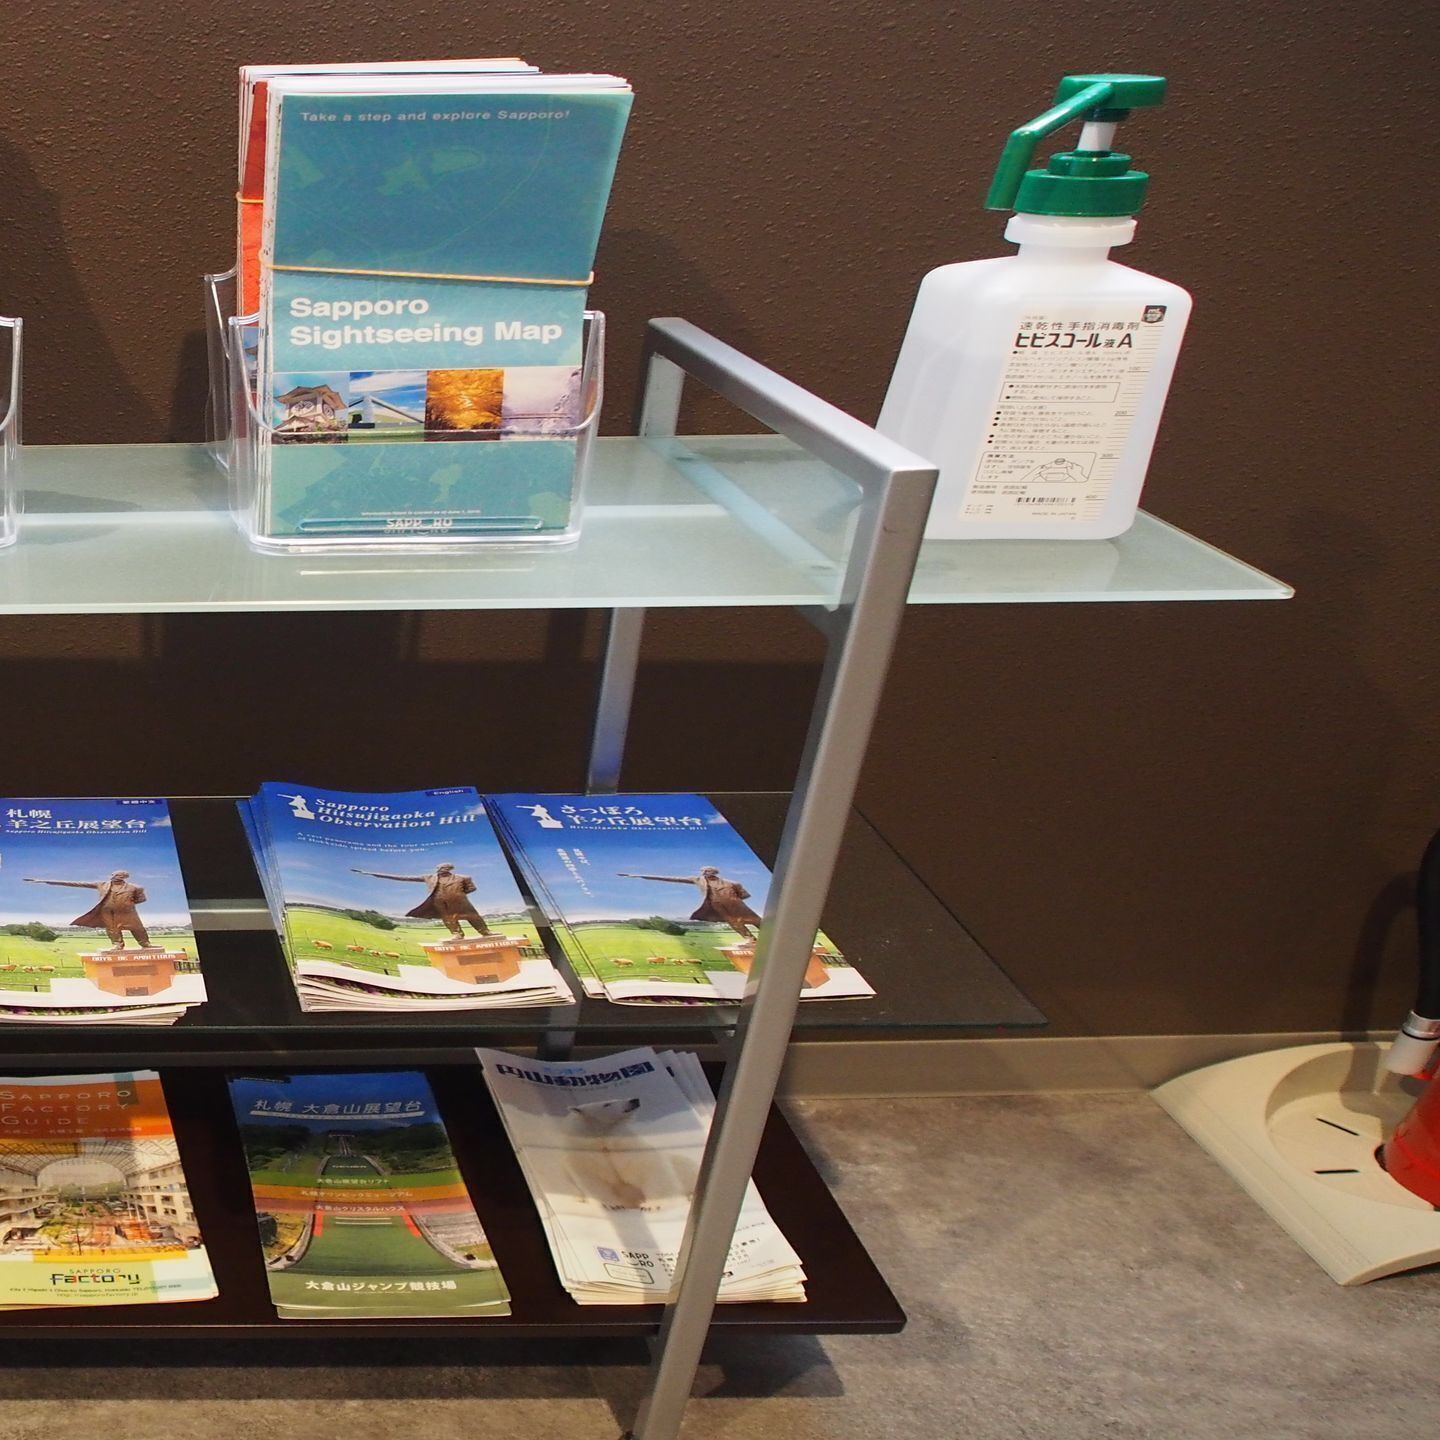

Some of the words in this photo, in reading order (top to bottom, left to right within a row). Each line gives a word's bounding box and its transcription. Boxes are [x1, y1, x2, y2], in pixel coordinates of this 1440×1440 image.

[300, 110, 336, 122] Take
[344, 113, 353, 122] a
[358, 111, 392, 124] step
[397, 110, 426, 121] and
[432, 110, 491, 123] explore
[497, 109, 570, 122] Sapporo!
[290, 297, 429, 320] Sapporo
[290, 322, 484, 348] Sightseeing
[495, 321, 562, 343] Map
[314, 798, 390, 812] Sapporo
[560, 804, 643, 816] さっぽろ
[6, 808, 52, 819] 札幌
[317, 807, 436, 821] Hitsujigaoka
[6, 819, 147, 830] 羊之丘展望台
[319, 815, 432, 829] Observation
[439, 814, 478, 826] Hill
[0, 1090, 131, 1100] SAPPORO
[1, 1103, 129, 1113] FACTORY
[254, 1099, 294, 1112] 札幌
[302, 1100, 422, 1114] 大倉山展望台
[1, 1115, 89, 1125] GUIDE
[304, 1280, 457, 1291] 大倉山ジャンプ競技場
